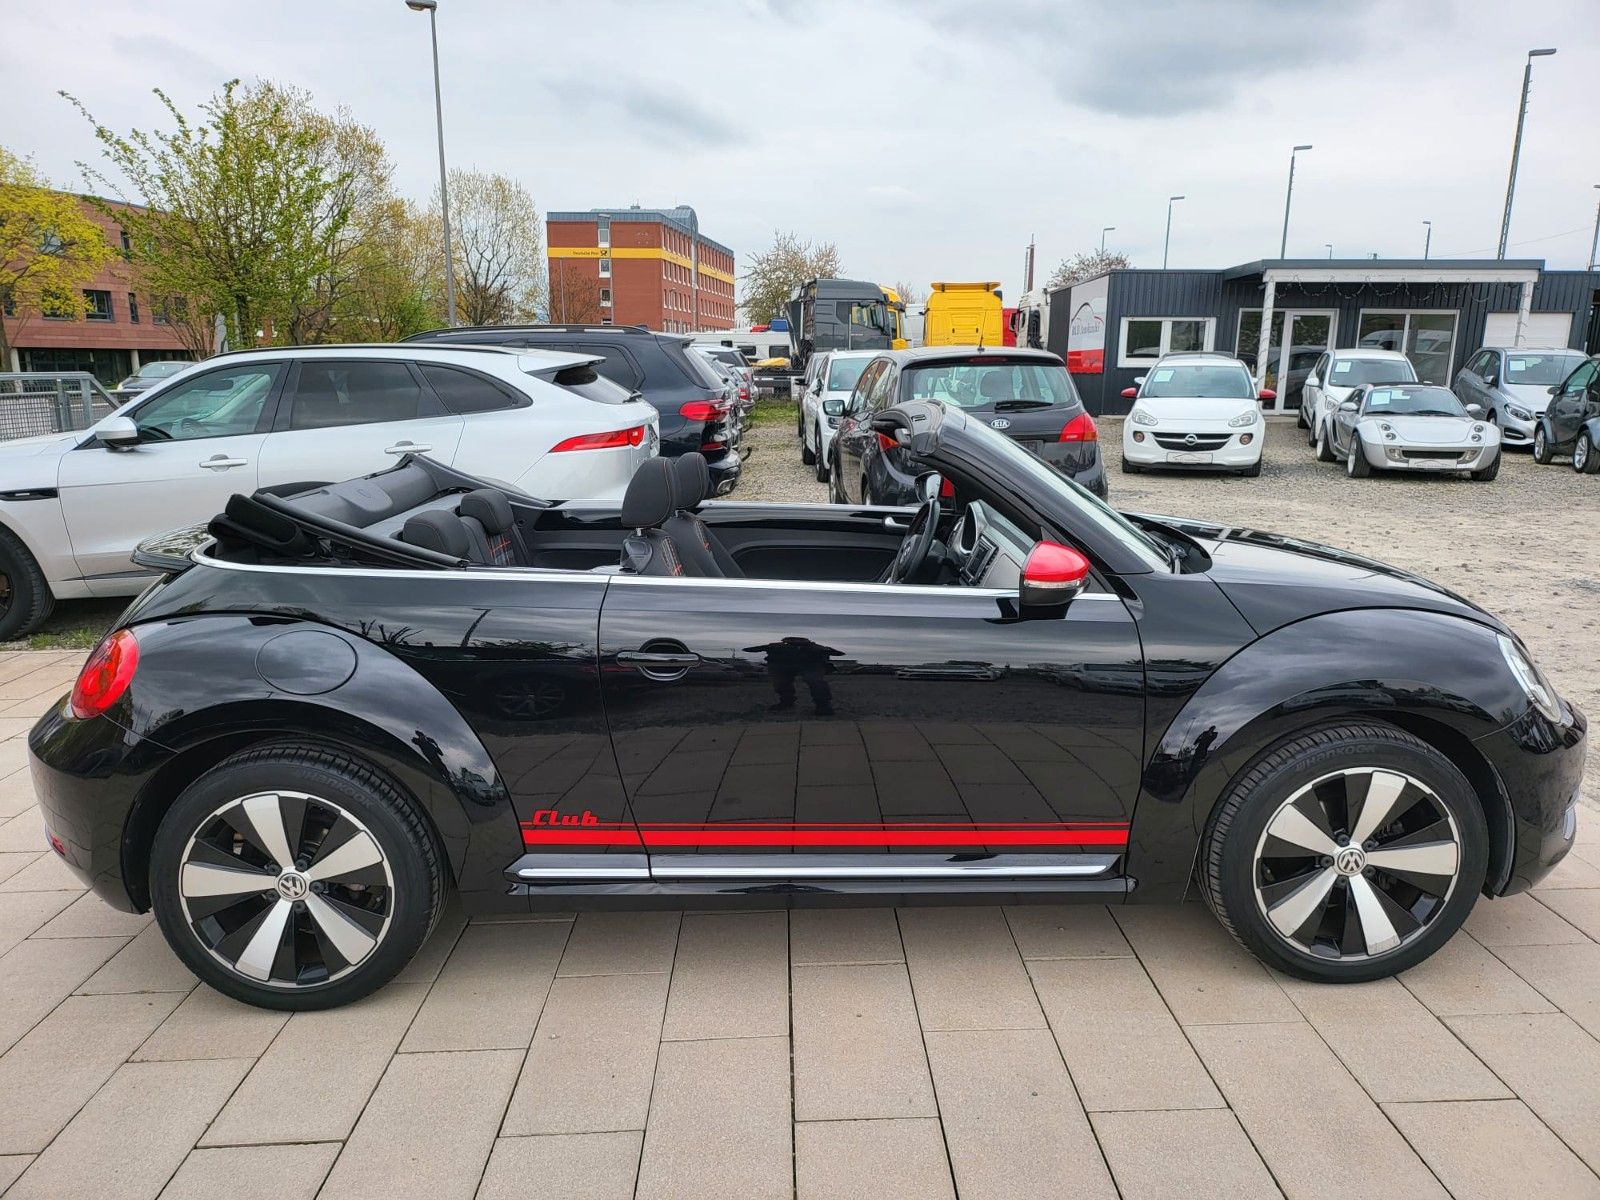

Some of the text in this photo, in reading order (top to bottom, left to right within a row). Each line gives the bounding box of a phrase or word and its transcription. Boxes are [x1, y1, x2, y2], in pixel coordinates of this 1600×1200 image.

[991, 419, 1010, 429] KIA
[532, 809, 599, 827] Club
[1338, 848, 1365, 873] VW
[278, 873, 307, 899] VW
